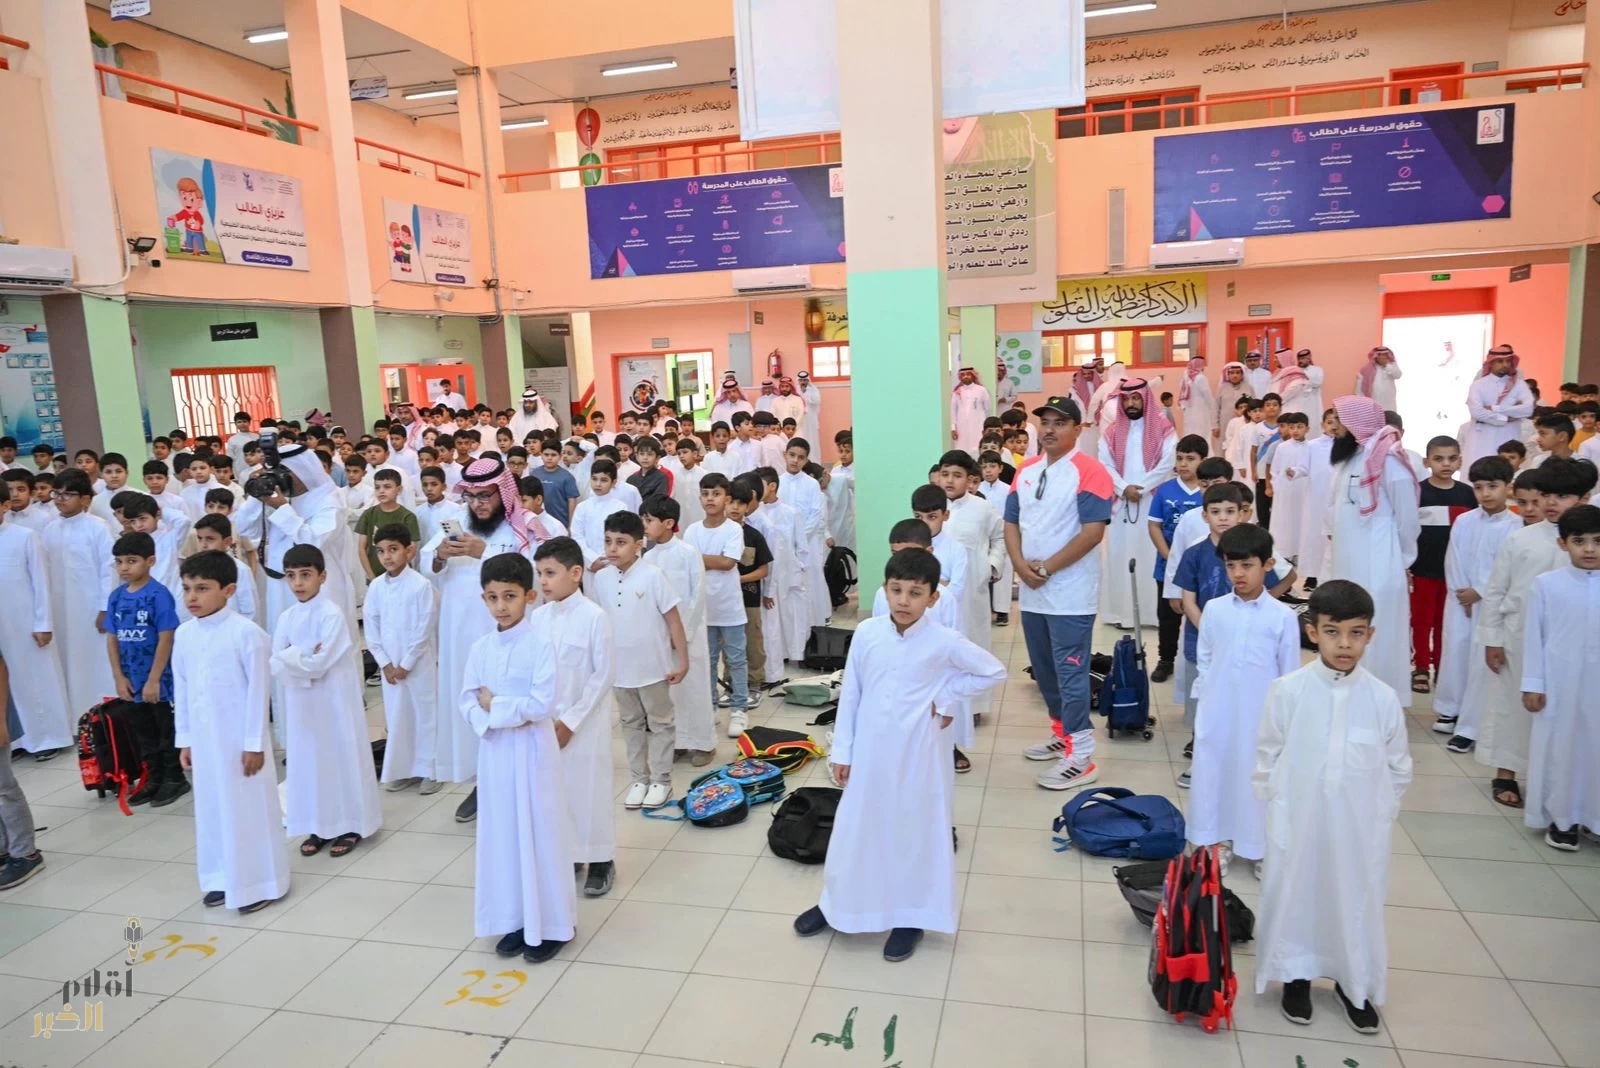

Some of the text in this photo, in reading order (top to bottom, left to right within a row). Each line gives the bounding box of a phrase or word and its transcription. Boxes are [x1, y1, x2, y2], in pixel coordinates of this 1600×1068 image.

[1309, 120, 1422, 137] حقوق المدرسة على الطالب
[964, 169, 994, 178] للمجد
[998, 168, 1027, 179] سارعي
[730, 180, 743, 188] على
[744, 178, 767, 186] الطالب
[768, 176, 787, 185] حقوق
[963, 185, 993, 196] لخالق
[997, 183, 1027, 194] مجدي
[966, 200, 998, 211] الخفاق
[1000, 197, 1027, 209] وارفعي
[236, 202, 285, 222] عزيزي الطالب
[968, 215, 998, 225] النور
[1001, 213, 1027, 223] يحمل
[962, 233, 969, 241] يا
[993, 229, 1006, 237] الله
[1009, 229, 1028, 237] رددي
[432, 235, 447, 245] الطالب
[959, 246, 974, 256] فخر
[977, 244, 997, 252] عشت
[1000, 243, 1028, 254] موطني
[966, 260, 985, 268] للعلم
[987, 259, 1005, 267] الملك
[1008, 257, 1028, 267] عاش
